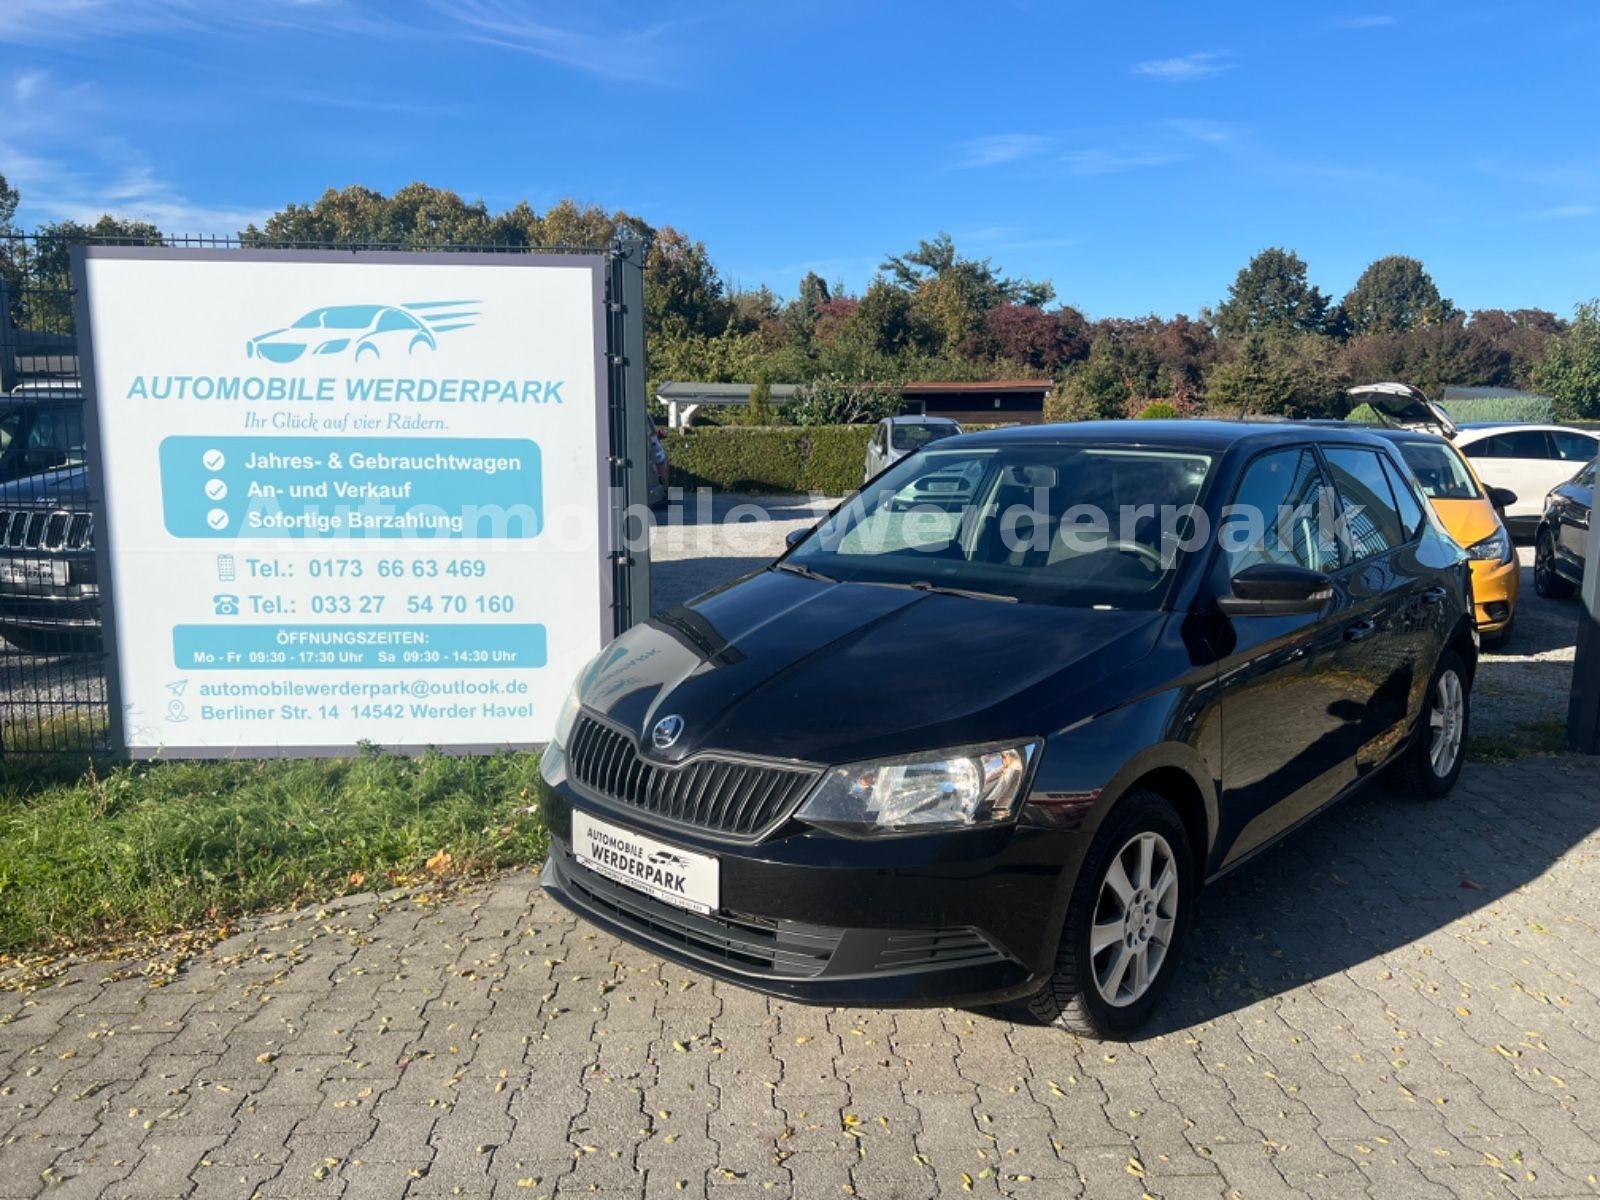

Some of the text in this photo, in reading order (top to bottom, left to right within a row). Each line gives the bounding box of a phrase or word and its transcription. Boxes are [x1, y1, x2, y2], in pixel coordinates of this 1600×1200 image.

[126, 375, 565, 404] AUTOMOBILE WERDERPARK
[243, 411, 450, 432] Ihr Glück auf vier Rädern.
[244, 453, 522, 475] Jahres- & Gebrauchtwagen
[247, 481, 412, 499] An- und Verkauf
[248, 511, 463, 533] Sofortige Barzahlung
[246, 559, 486, 578] Tel.: 0173 66 63 469
[248, 595, 514, 614] Tel.: 033 27 54 70 160
[276, 630, 430, 645] ÖFFNUNGSZEITEN:
[194, 651, 215, 664] Mo
[227, 651, 242, 664] Fr
[249, 651, 286, 663] 09:30
[299, 651, 335, 663] 17:30
[339, 651, 363, 663] Uhr
[378, 651, 396, 663] Sa
[403, 651, 439, 663] 09:30
[452, 650, 489, 663] 14:30
[492, 650, 517, 663] Uhr
[199, 679, 528, 698] automobilewerderpark@outlook.de
[201, 702, 534, 721] Berliner Str. 14 14542 Werder Havel
[587, 827, 644, 858] AUTOMOBILE
[591, 843, 687, 893] WERDERPARK
